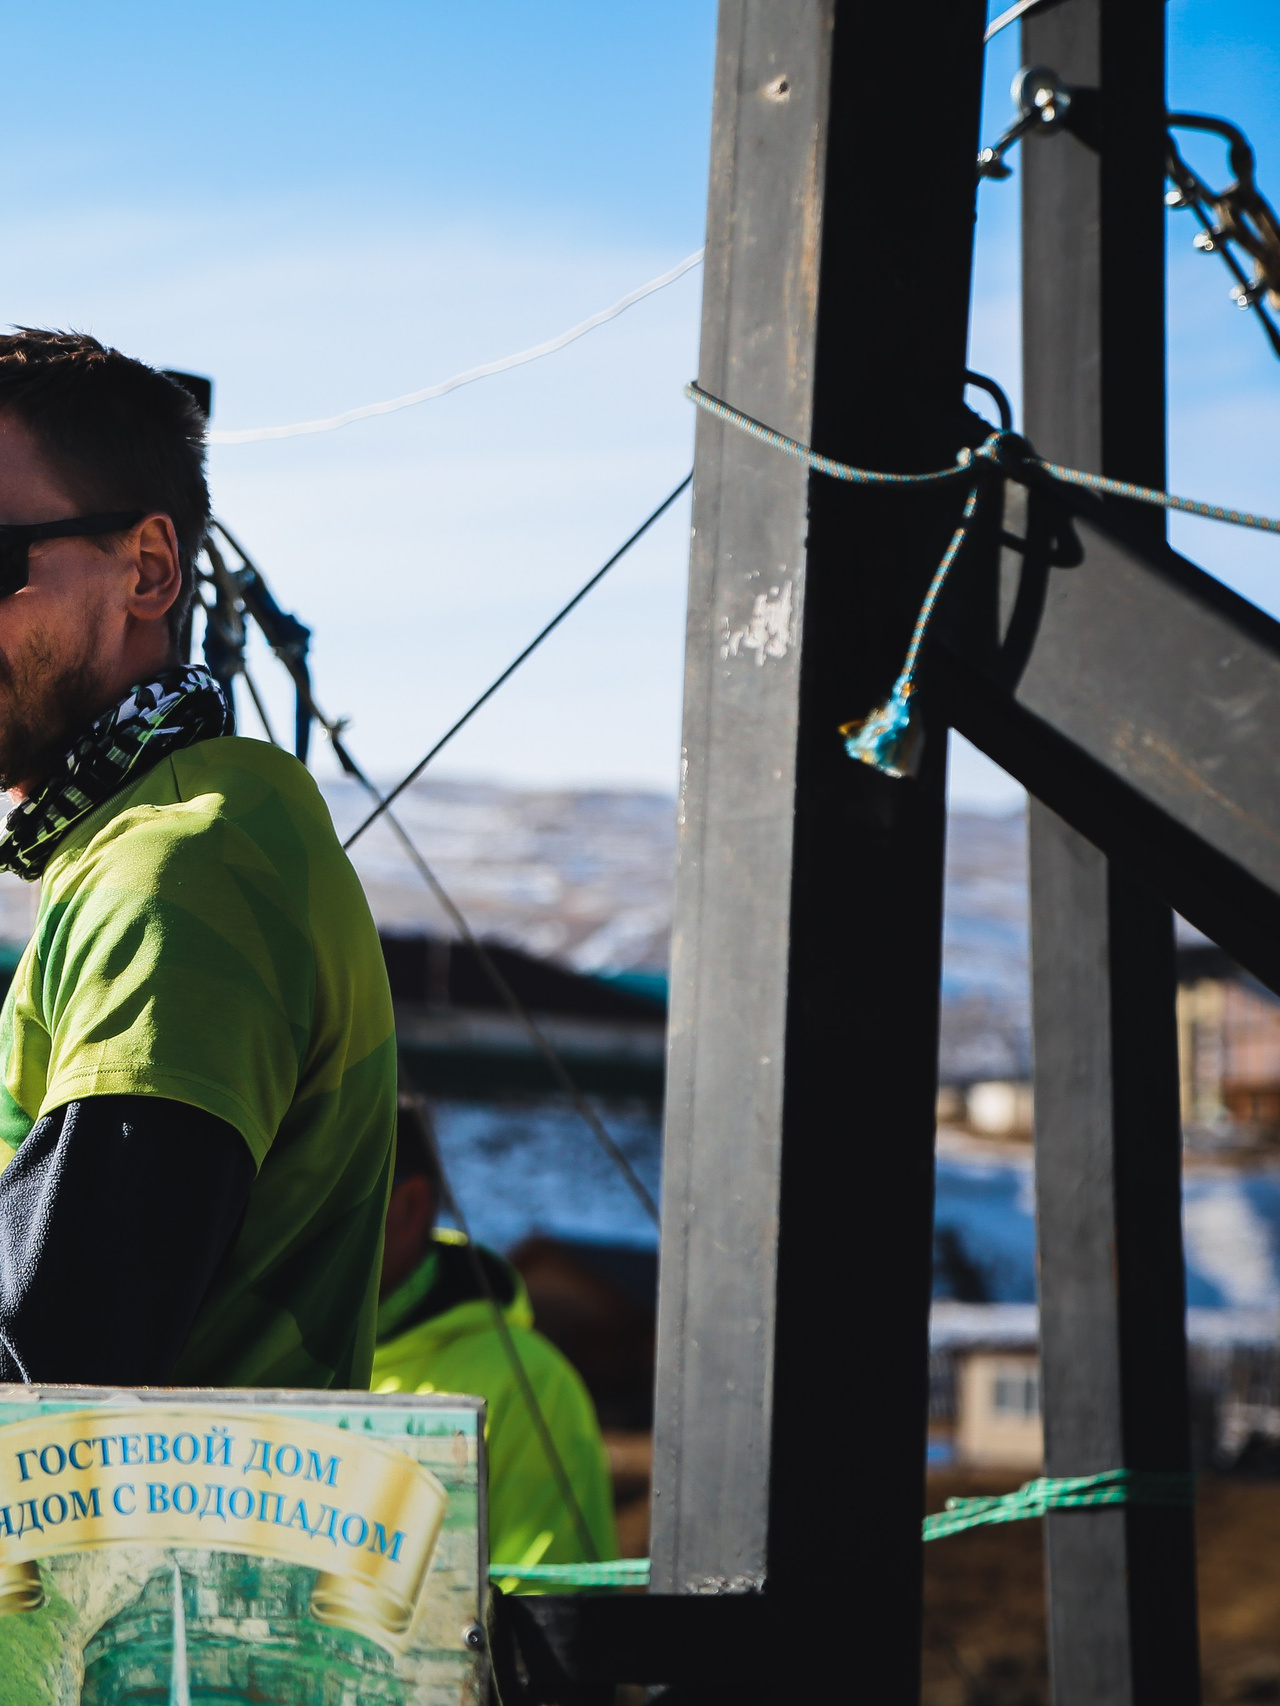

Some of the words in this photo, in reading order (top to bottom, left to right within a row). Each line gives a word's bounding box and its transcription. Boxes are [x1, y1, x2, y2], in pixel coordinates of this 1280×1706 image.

[15, 1427, 234, 1482] ГОСТЕВОЙ
[243, 1439, 341, 1486] ДОМ
[113, 1483, 137, 1516] С
[146, 1482, 407, 1562] ВОДОПАДОМ
